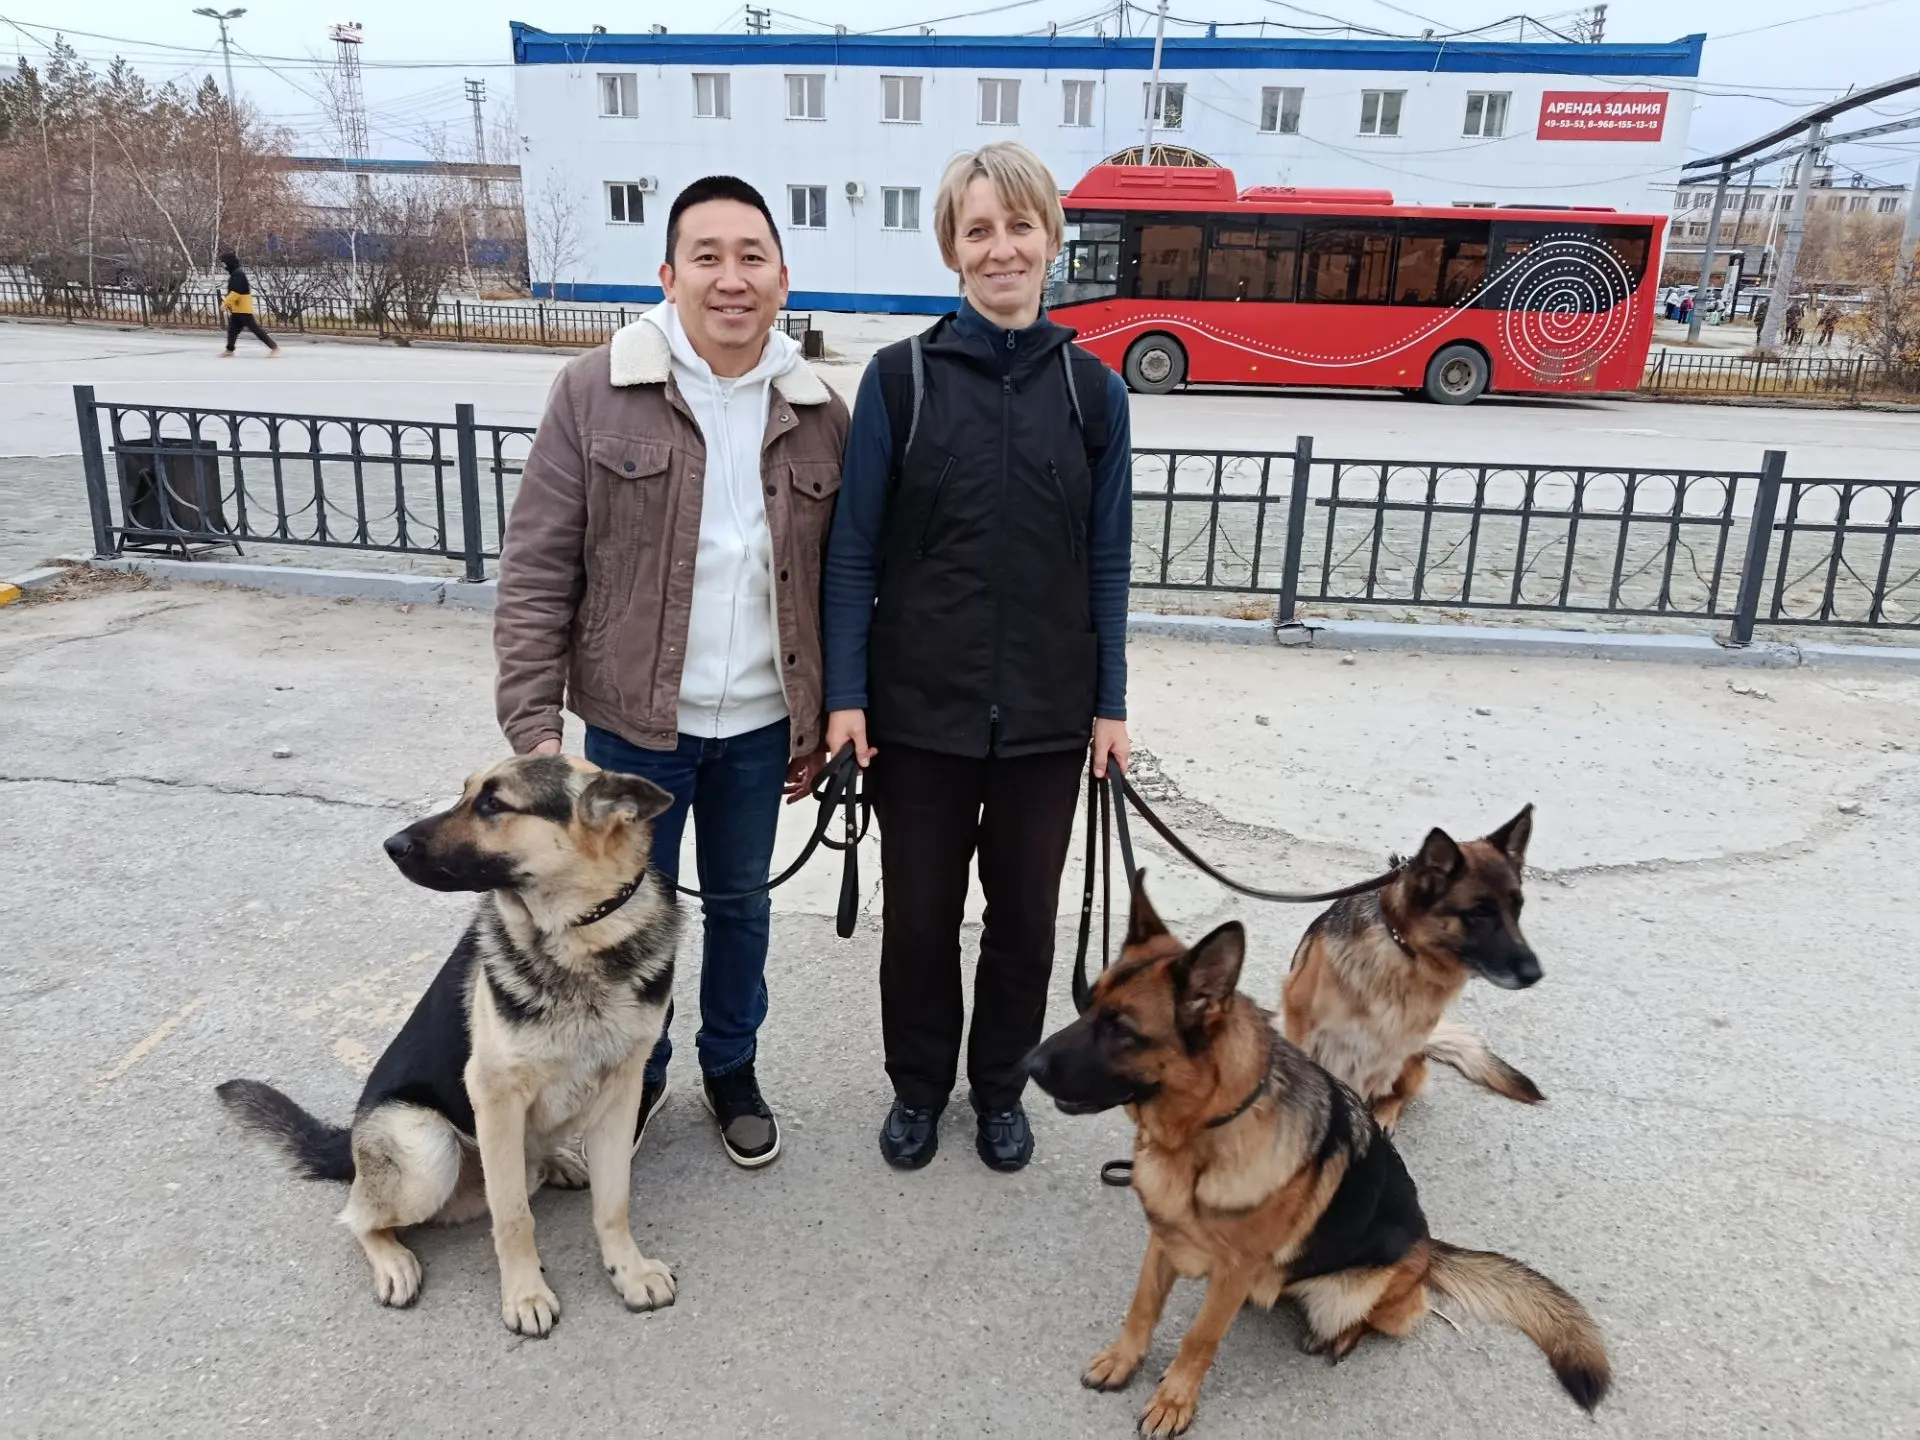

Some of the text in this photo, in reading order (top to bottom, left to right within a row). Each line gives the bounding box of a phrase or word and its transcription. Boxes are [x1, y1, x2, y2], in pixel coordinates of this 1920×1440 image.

[1547, 102, 1661, 116] АРЕНДА ЗДАНИЯ
[1545, 119, 1658, 129] 49-53-53, 8-968-155-13-13
